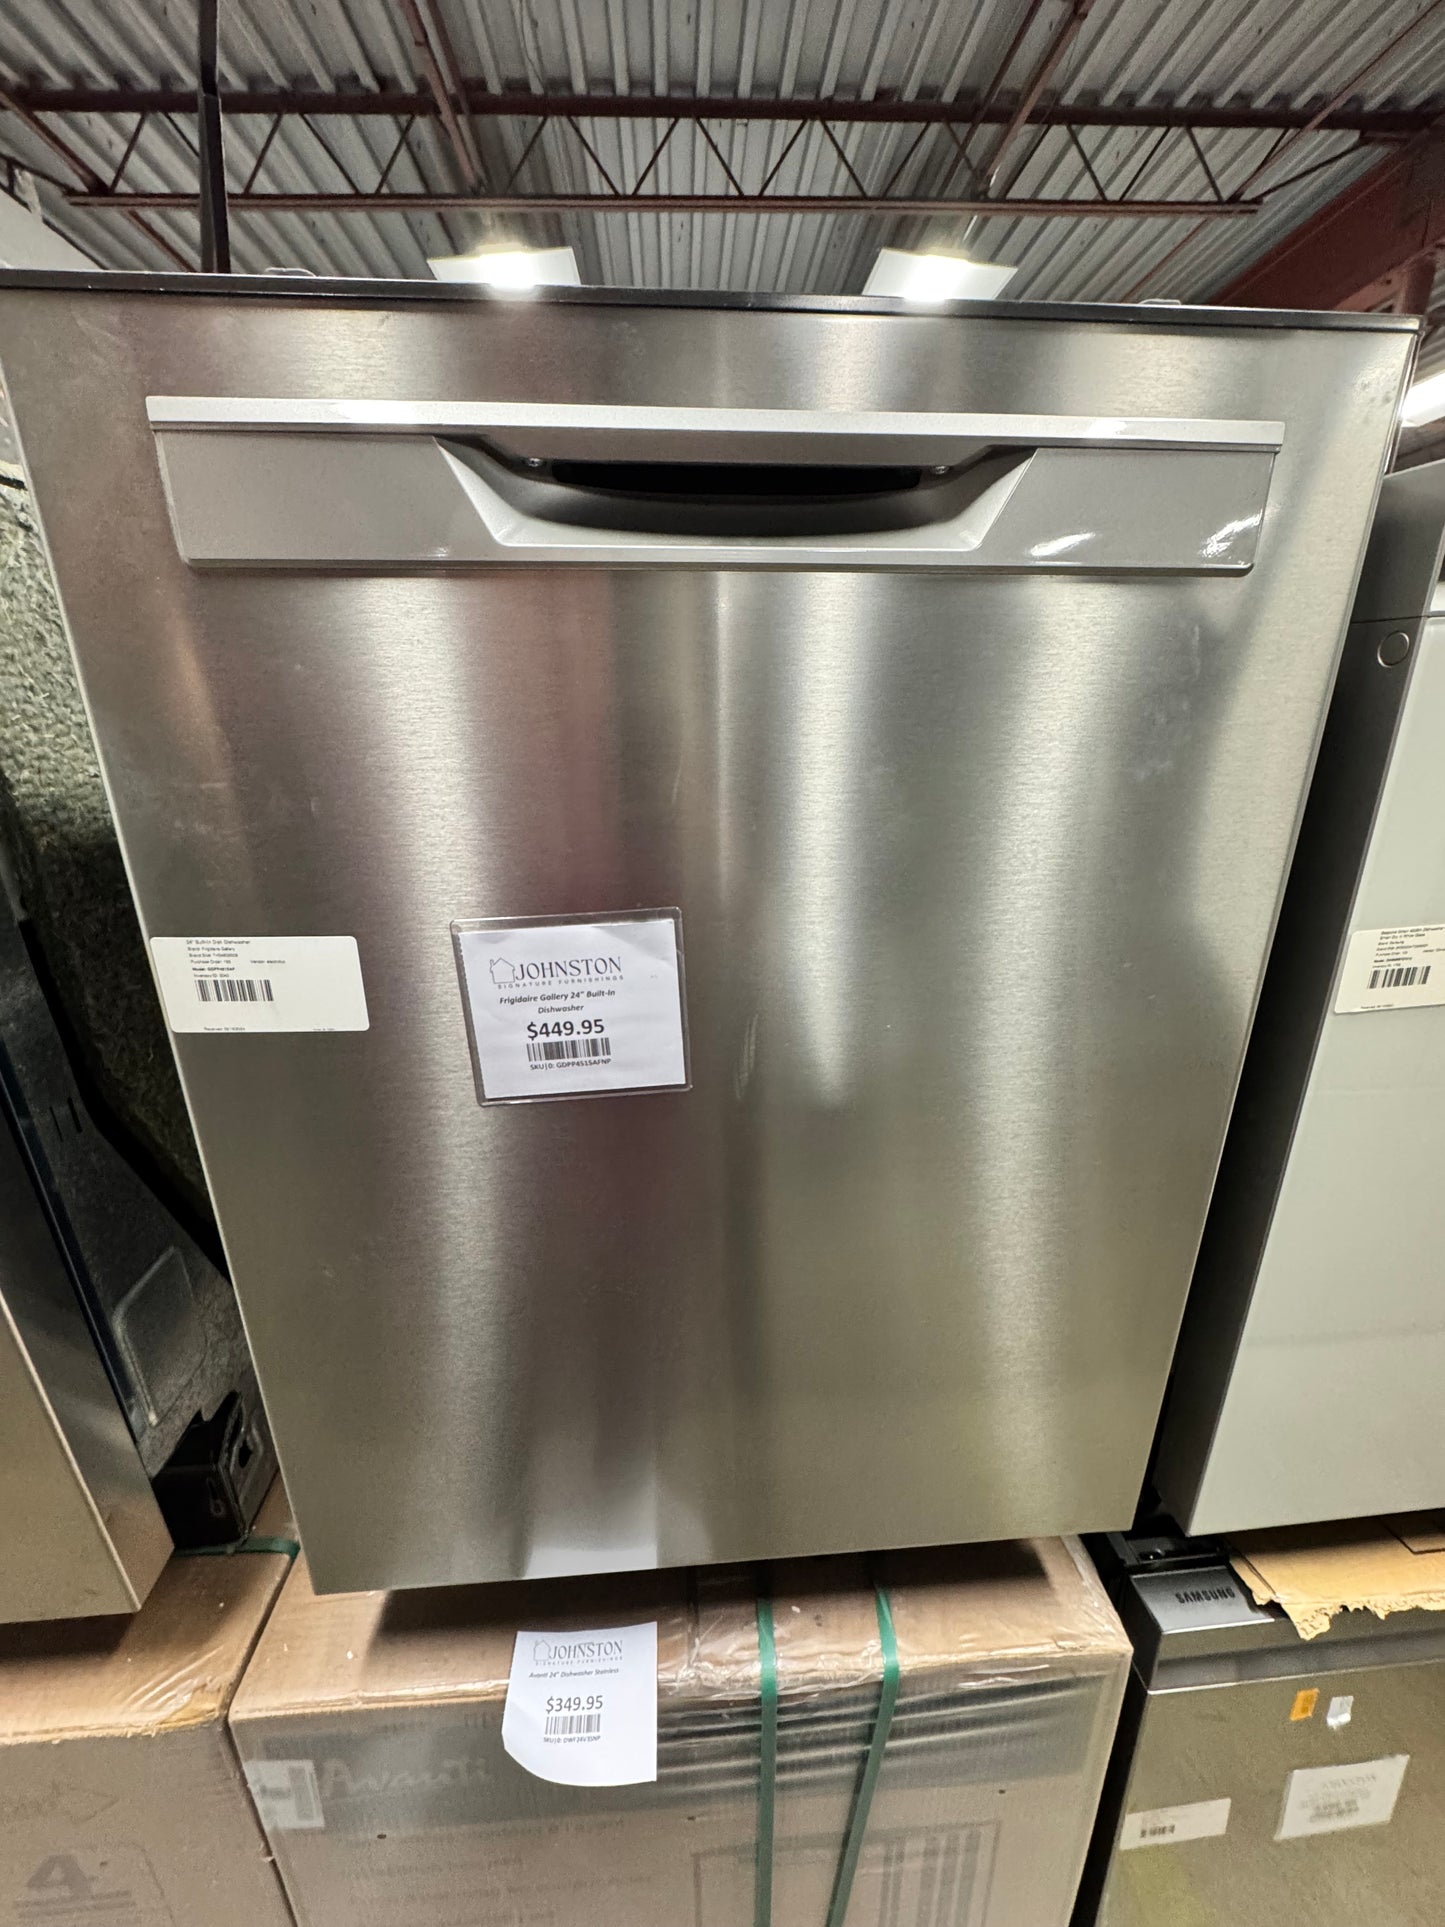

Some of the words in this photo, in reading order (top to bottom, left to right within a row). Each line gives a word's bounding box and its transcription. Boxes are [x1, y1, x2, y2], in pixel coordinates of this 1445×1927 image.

[515, 956, 623, 981] JOHNSTON
[498, 980, 552, 989] SIGNATURE
[558, 974, 624, 985] FURNISHINGS
[499, 994, 538, 1005] Frigidaire
[539, 992, 569, 1003] Gallery
[586, 988, 616, 999] Built-In
[537, 1004, 585, 1014] Dishwasher
[526, 1018, 605, 1041] $449.95
[1174, 1586, 1236, 1604] SAMSUNG
[550, 1639, 623, 1660] JOHNSTON
[560, 1669, 594, 1678] Dishwasher
[545, 1695, 604, 1714] $349.95
